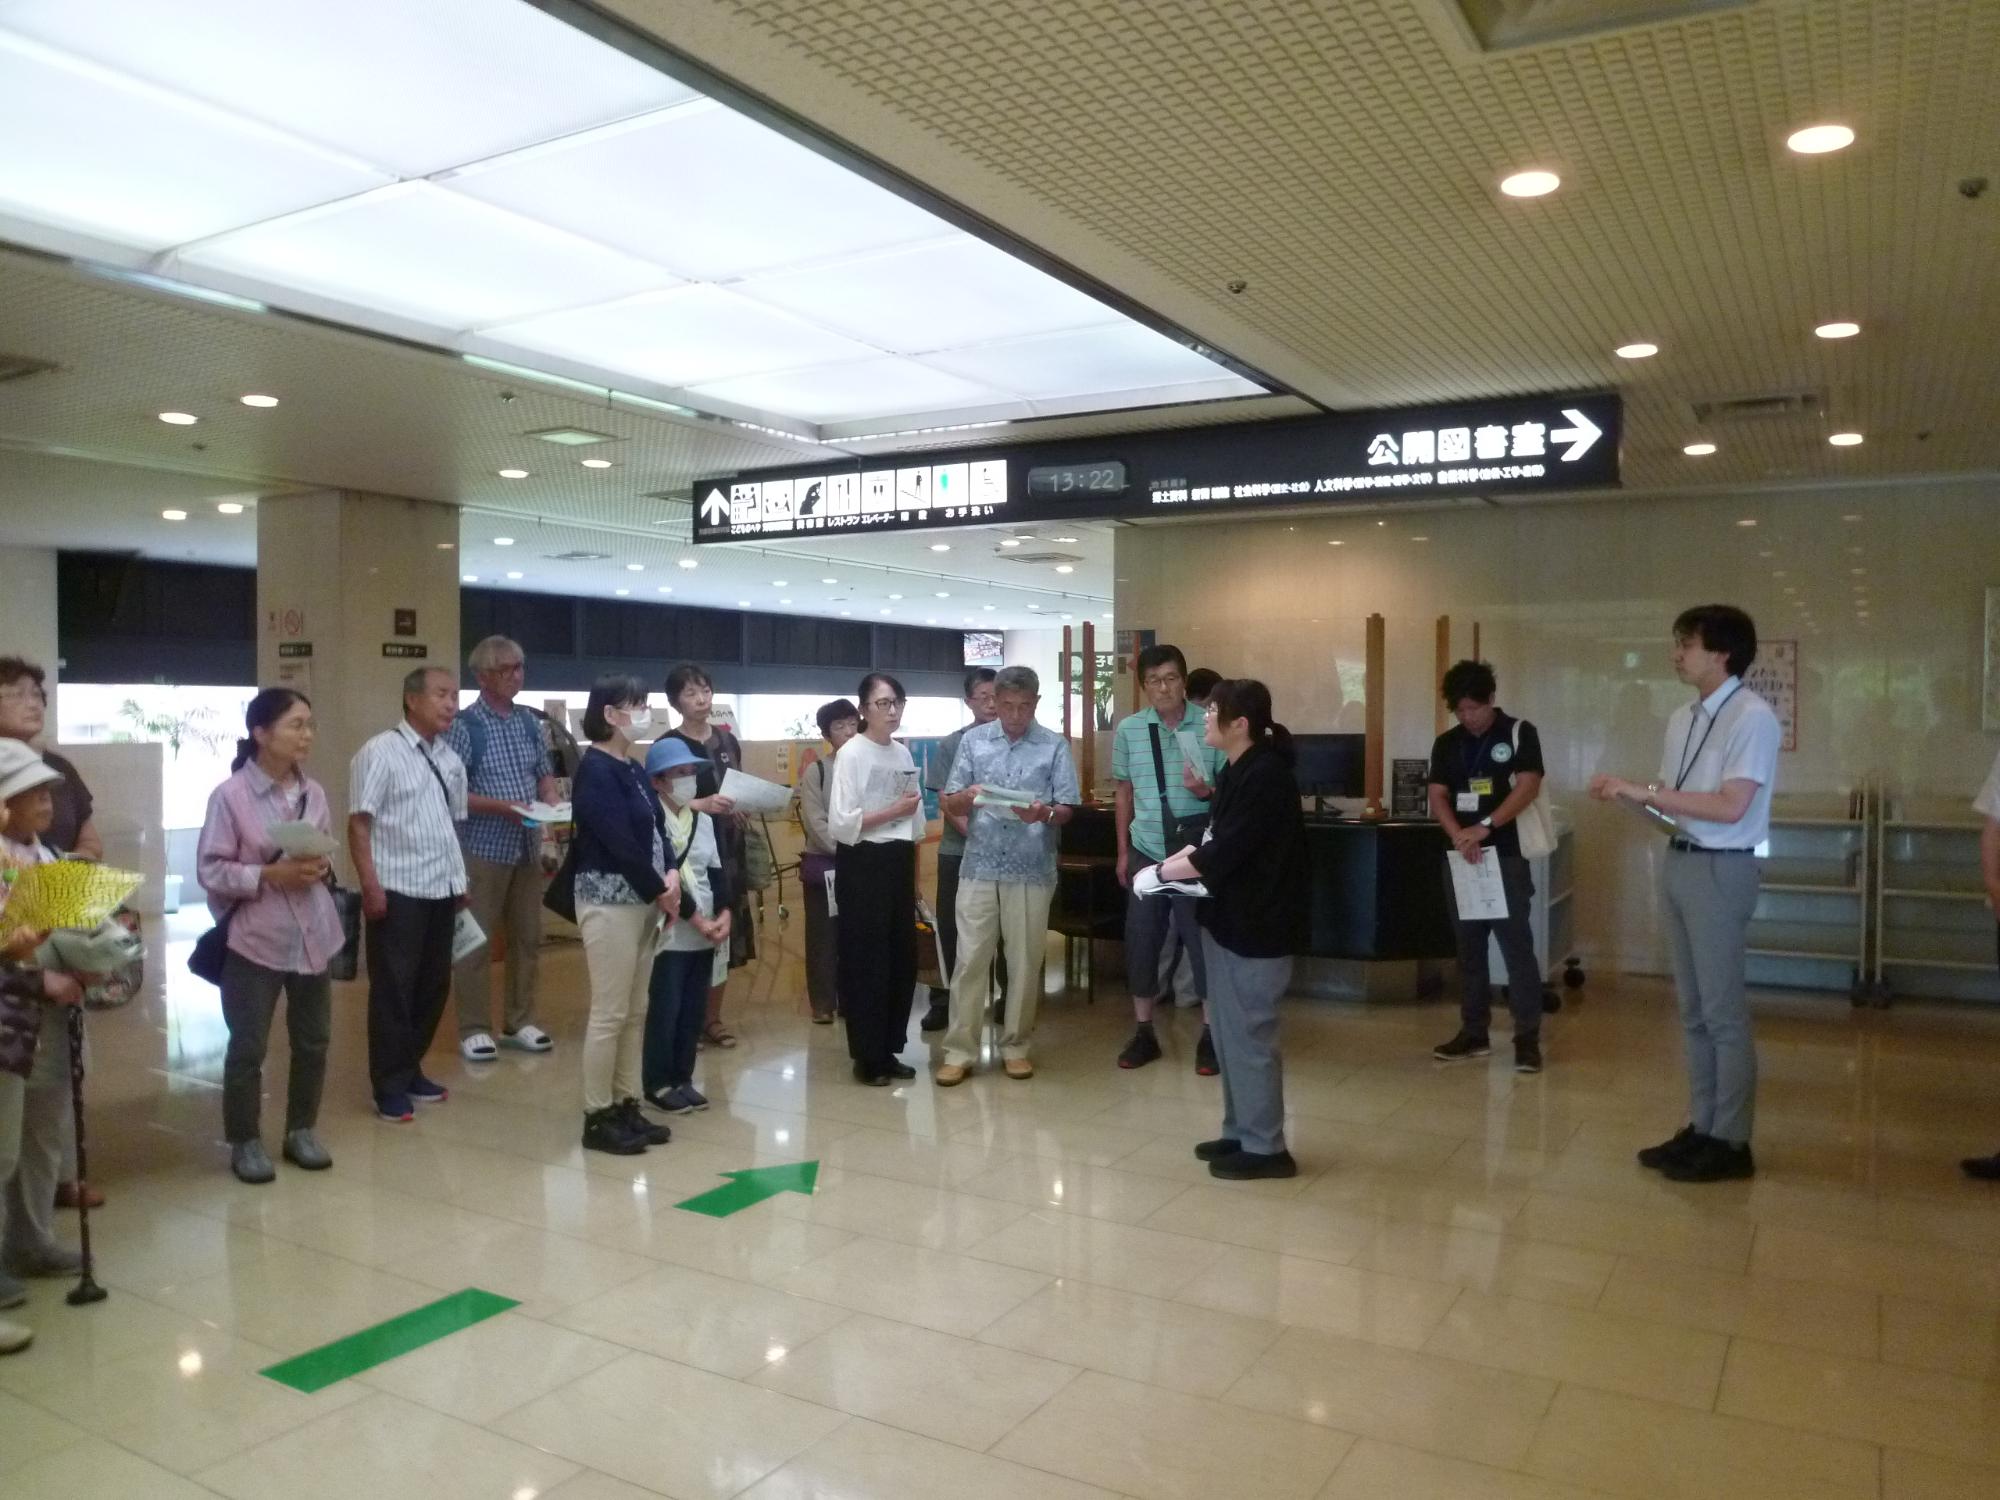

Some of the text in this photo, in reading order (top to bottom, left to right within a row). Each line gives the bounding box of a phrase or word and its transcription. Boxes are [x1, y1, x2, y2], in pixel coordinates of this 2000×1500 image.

[1367, 421, 1545, 465] 公開図書室
[1049, 470, 1114, 492] 13:22
[861, 513, 895, 525] エレベーター
[945, 505, 995, 519] お手洗い
[827, 516, 860, 527] レストラン
